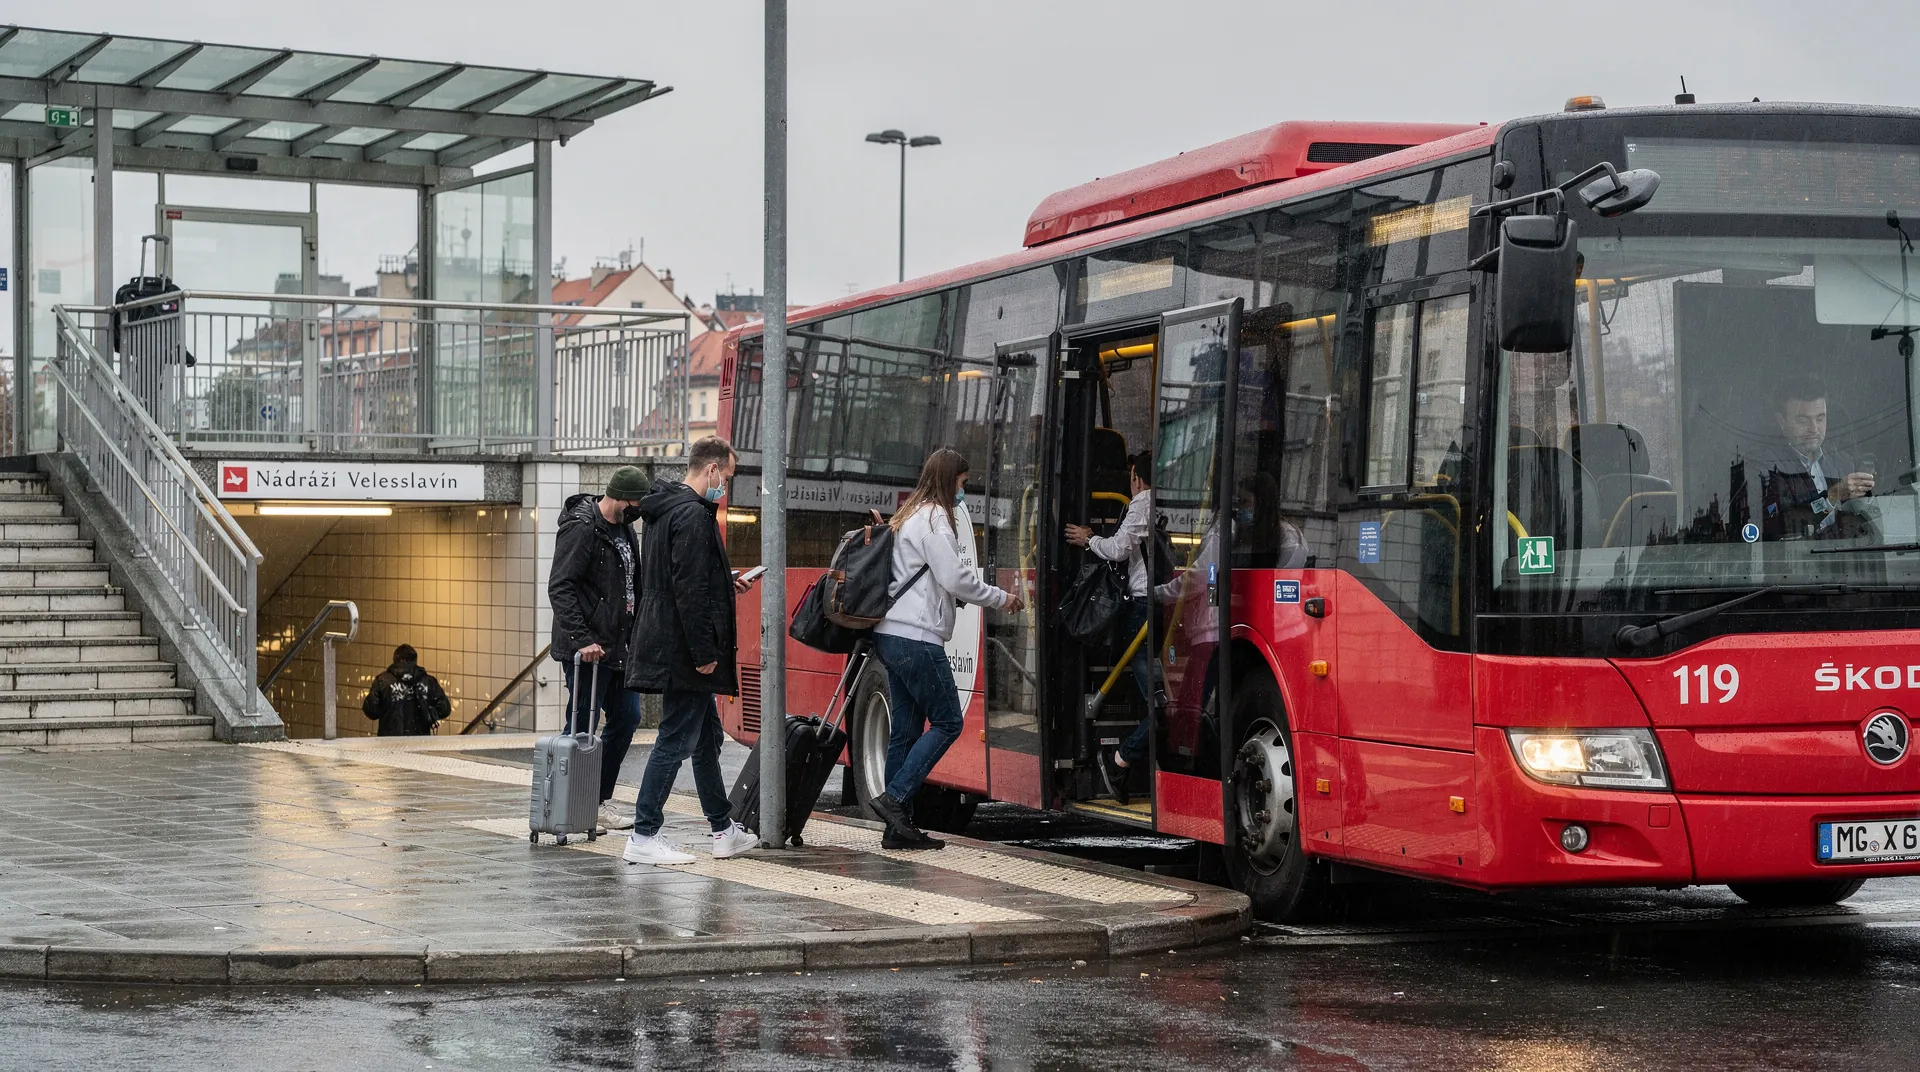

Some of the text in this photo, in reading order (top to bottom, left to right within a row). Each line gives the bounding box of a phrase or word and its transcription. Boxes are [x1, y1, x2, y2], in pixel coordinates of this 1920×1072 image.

[256, 470, 457, 489] Nádraží Velesslavín
[1673, 664, 1739, 704] 119
[1837, 826, 1868, 853] MG
